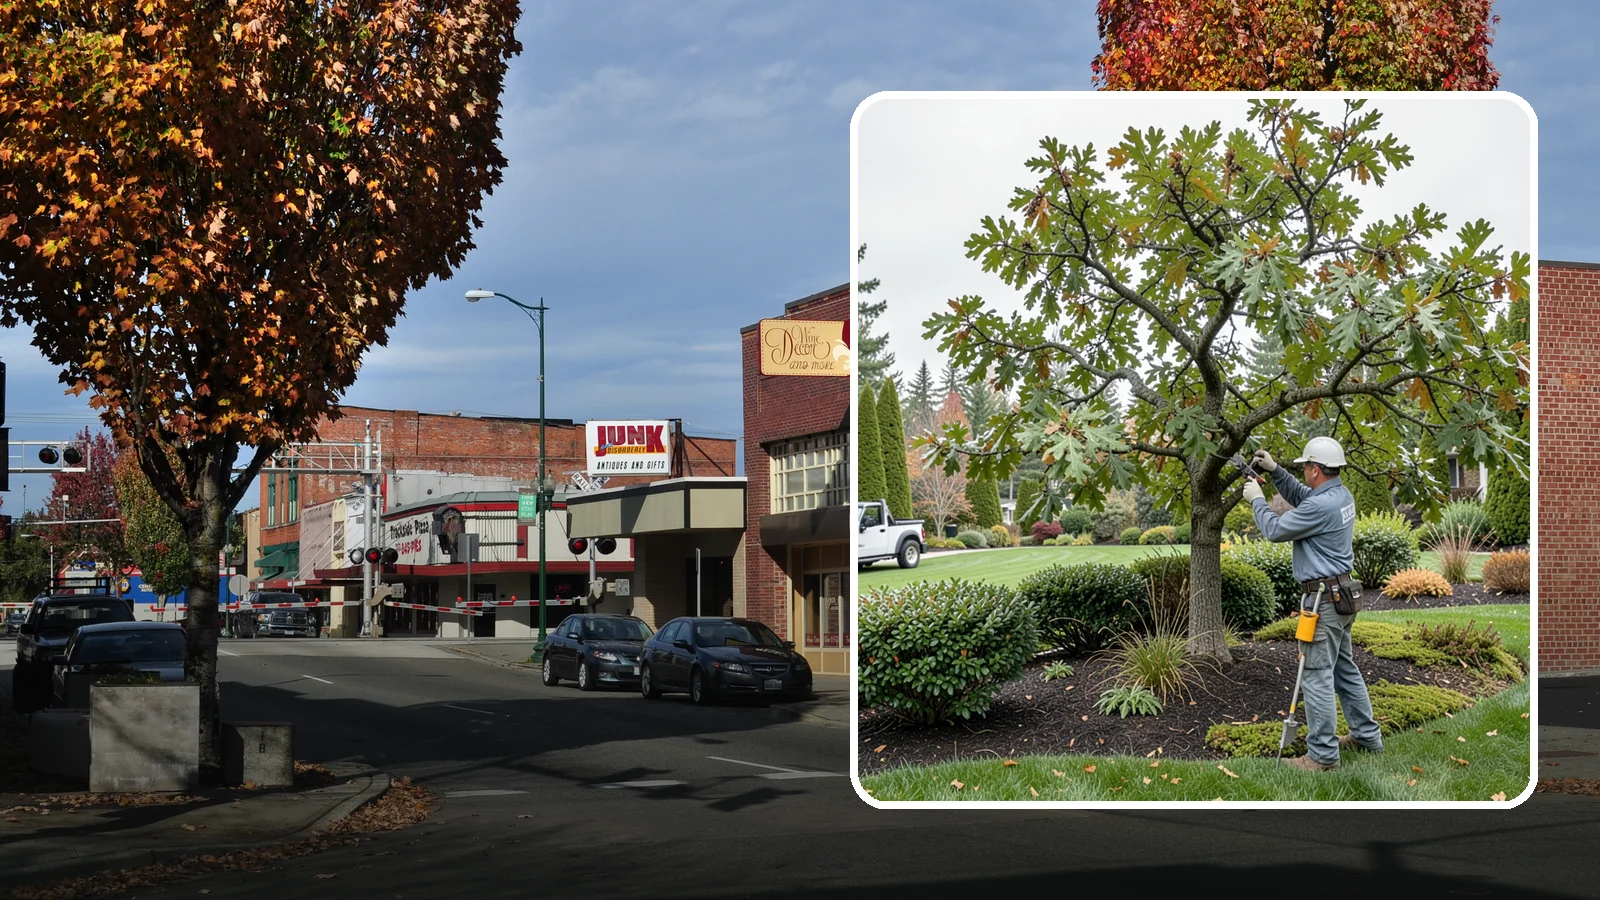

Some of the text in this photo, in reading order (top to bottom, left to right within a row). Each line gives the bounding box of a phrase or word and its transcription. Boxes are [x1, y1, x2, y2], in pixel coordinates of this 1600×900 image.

[595, 425, 665, 457] JUNK
[607, 446, 646, 454] DISORDERLY
[596, 460, 665, 470] ANTIQUES AND GIFTS
[390, 519, 429, 539] Trackside Pizza
